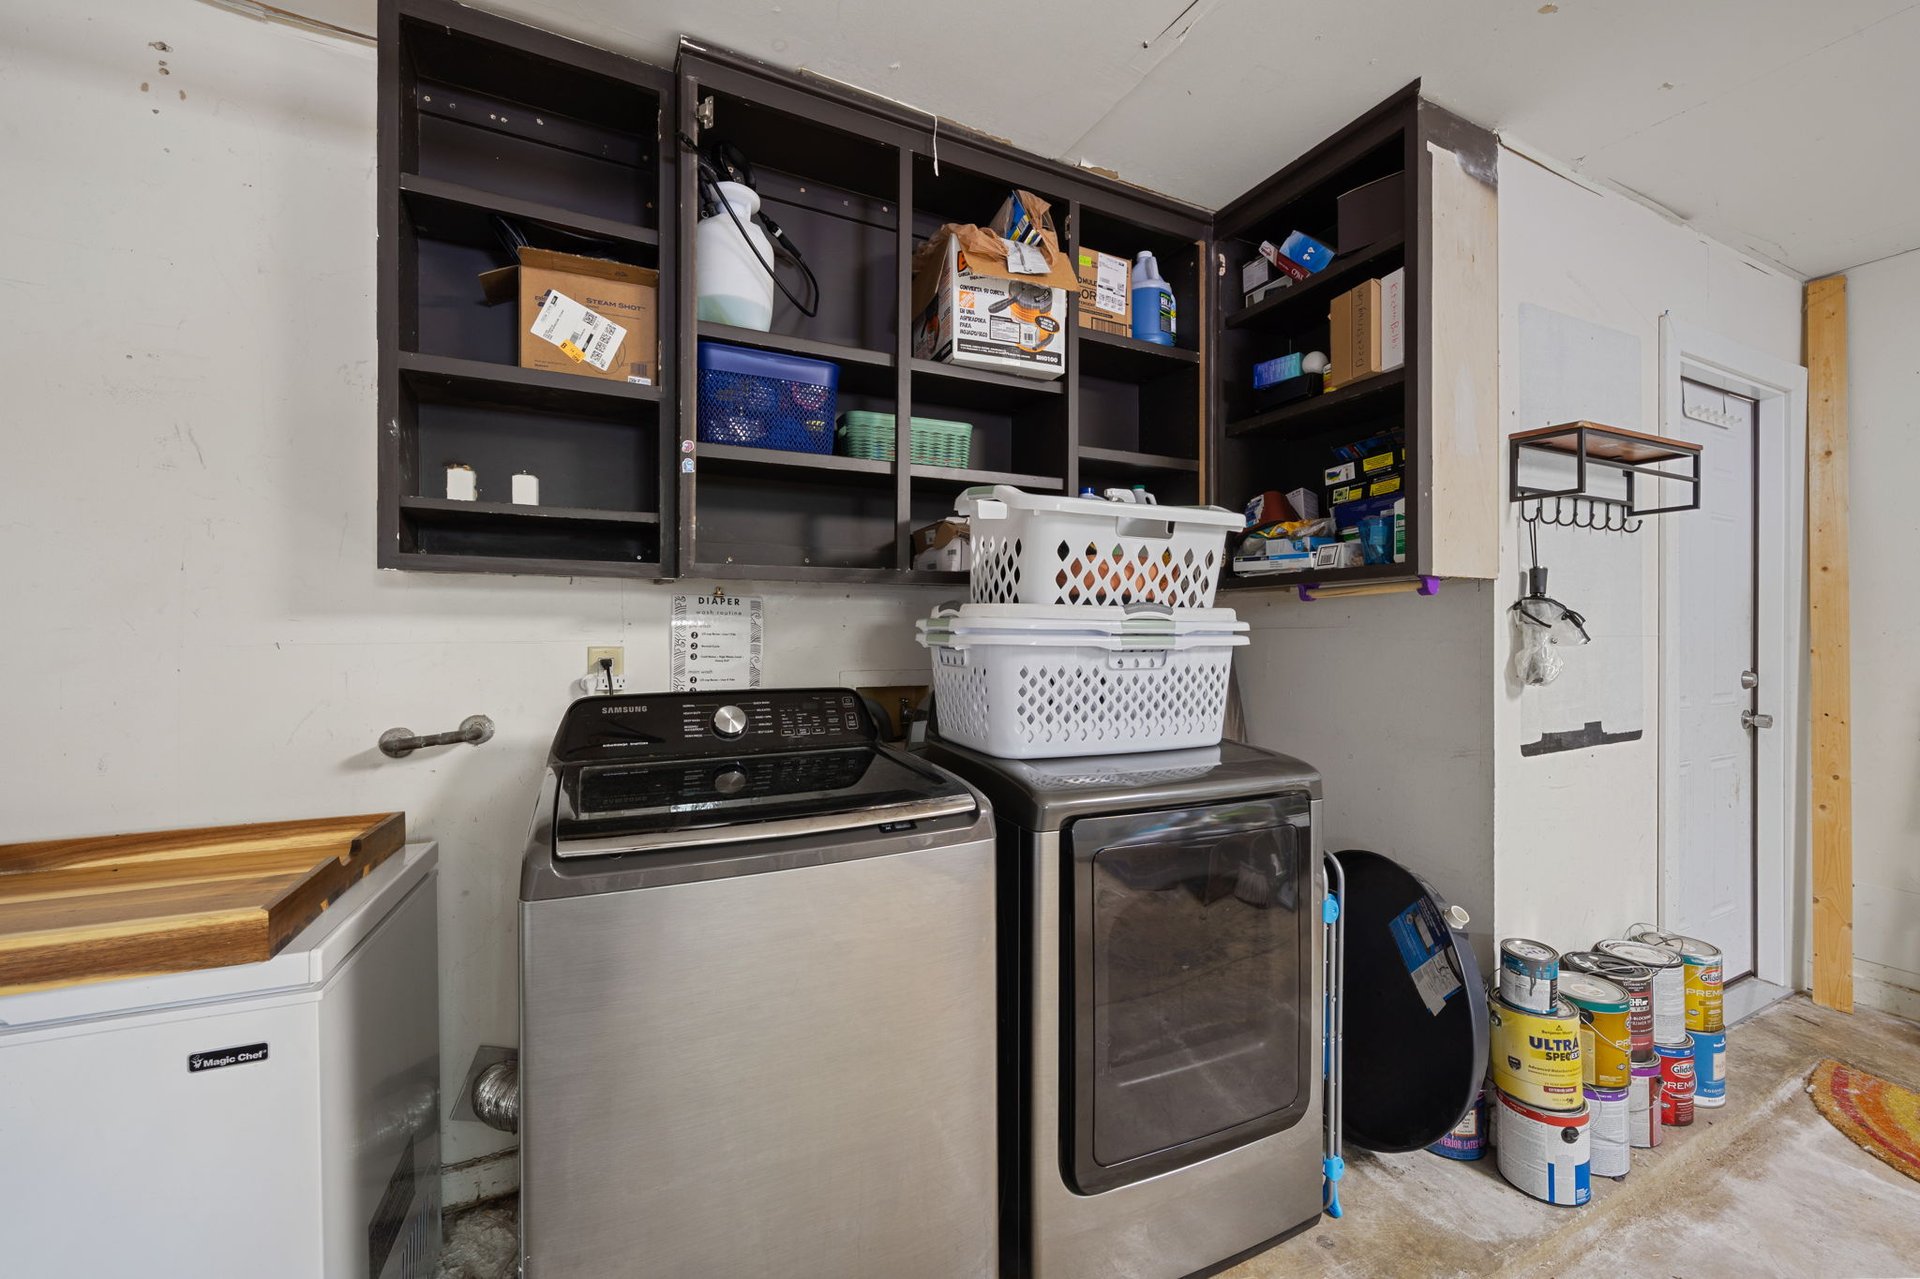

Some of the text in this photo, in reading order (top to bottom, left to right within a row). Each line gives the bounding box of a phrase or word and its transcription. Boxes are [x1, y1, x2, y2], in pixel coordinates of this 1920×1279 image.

[586, 297, 642, 311] STEAM SHOT
[698, 596, 741, 606] DIAPER
[601, 705, 648, 714] SAMSUNG
[1528, 1035, 1579, 1052] ULTRA
[203, 1050, 263, 1068] Magic Chef
[1545, 1051, 1572, 1062] SPEC
